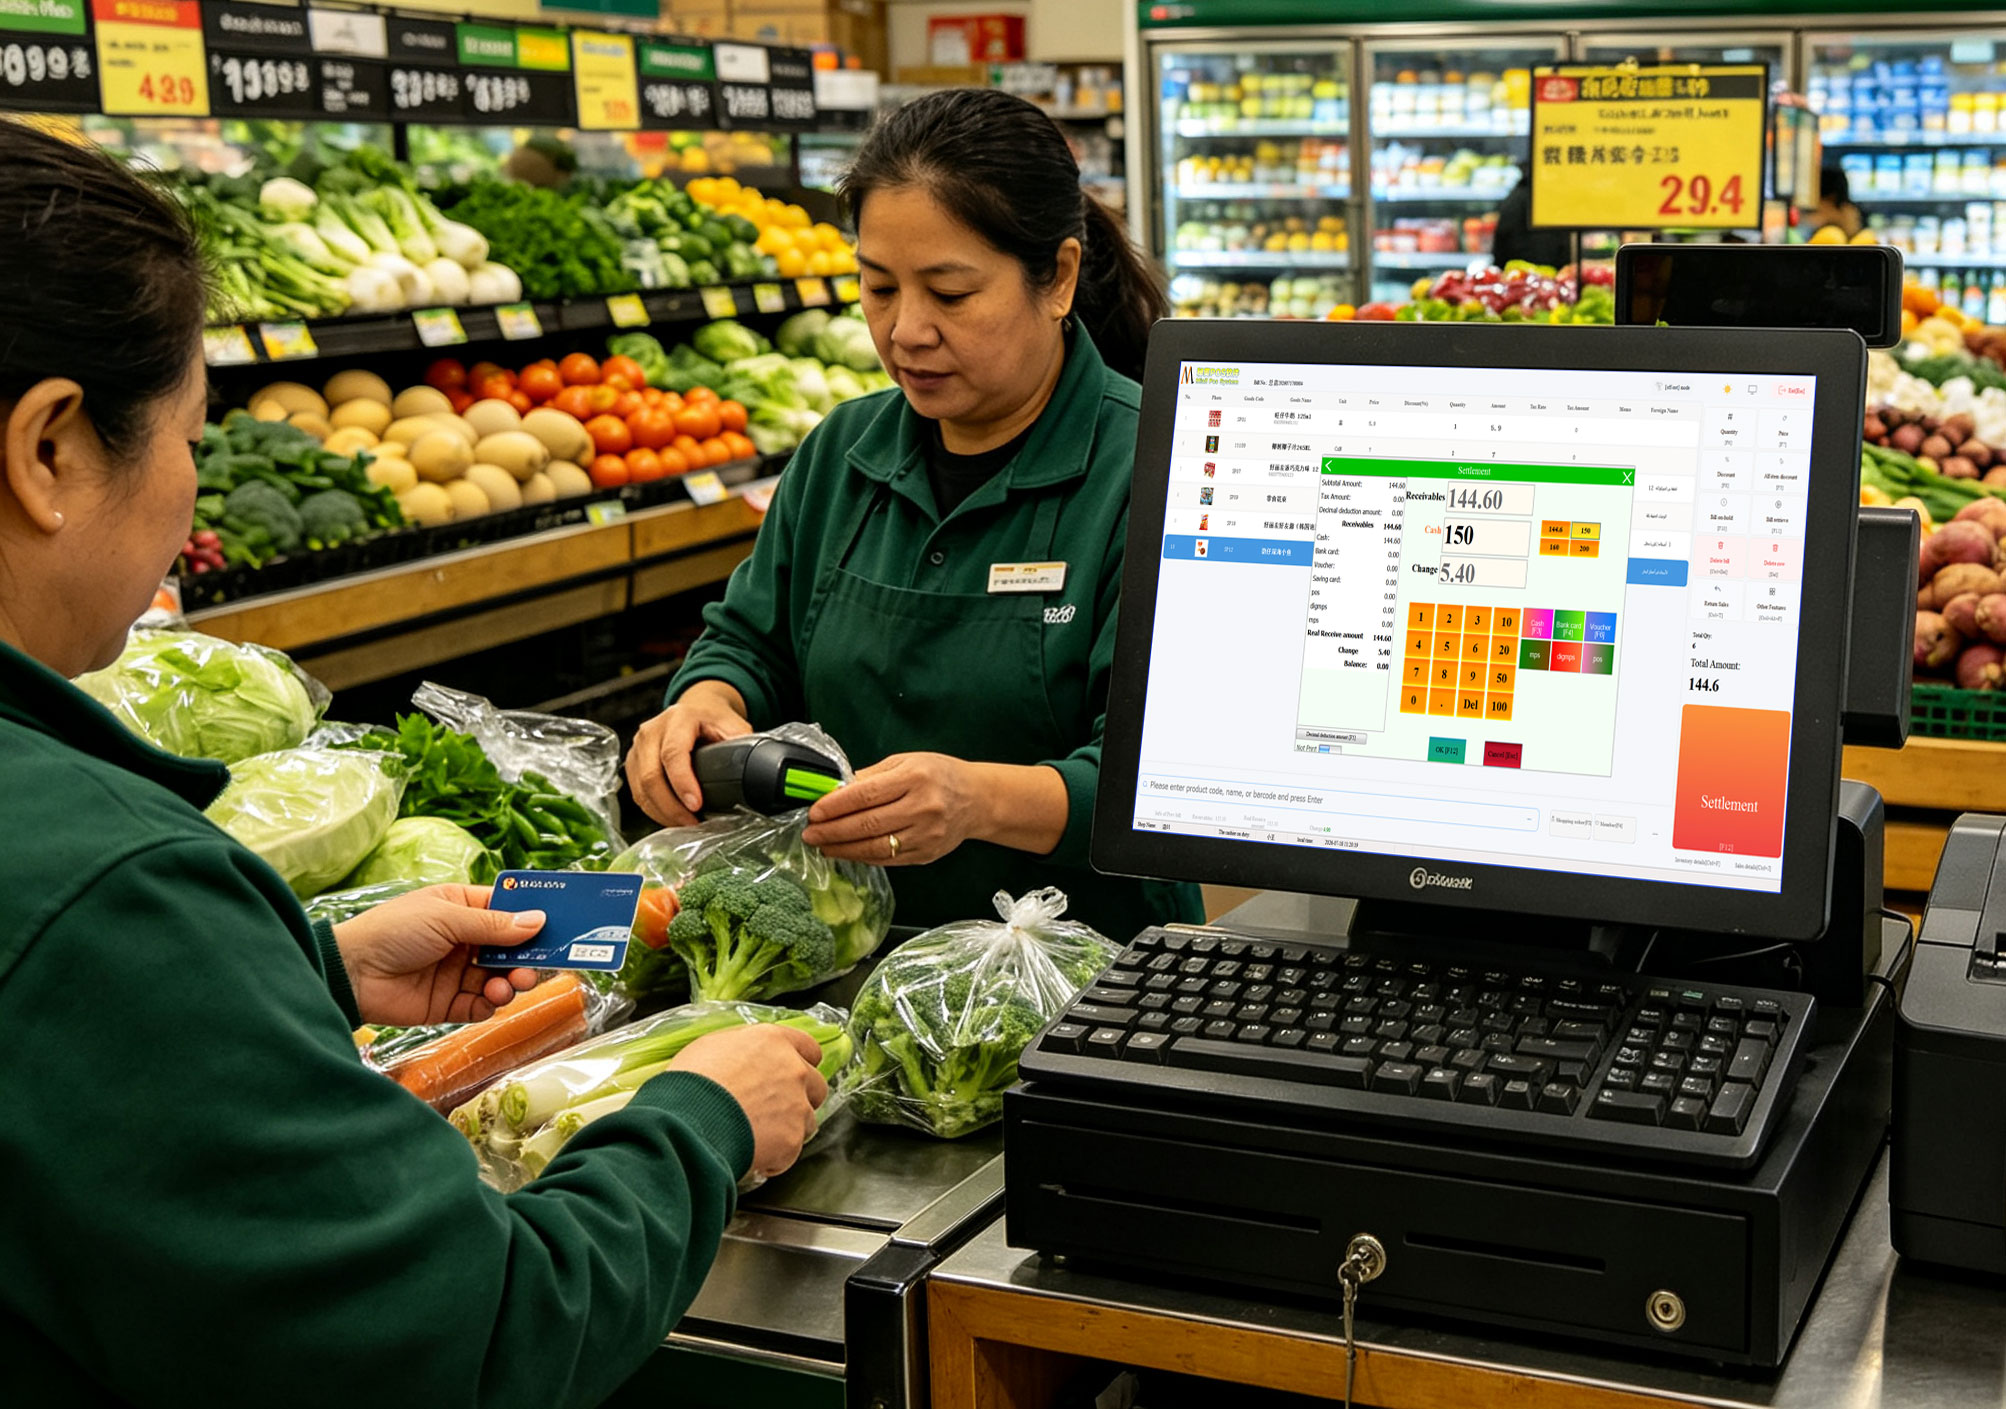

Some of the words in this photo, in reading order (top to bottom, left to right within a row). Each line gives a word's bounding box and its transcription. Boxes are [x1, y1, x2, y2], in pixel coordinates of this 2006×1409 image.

[1658, 174, 1744, 216] 29.4
[1457, 466, 1491, 477] Settlement
[1321, 478, 1341, 487] Subtotal
[1342, 480, 1362, 488] Amount:
[1388, 481, 1406, 490] 144.60
[1320, 492, 1329, 500] Tax
[1329, 493, 1351, 502] Amount:
[1393, 496, 1405, 504] 0.00
[1405, 490, 1446, 502] Receivables
[1448, 488, 1503, 510] 144.60
[1319, 505, 1337, 514] Decimal
[1337, 506, 1362, 516] deduction
[1362, 508, 1383, 517] amount:
[1391, 509, 1404, 517] 0.00
[1341, 520, 1374, 530] Receivables
[1383, 523, 1402, 532] 144.60
[1424, 524, 1442, 535] Cash
[1548, 525, 1563, 533] 144.6
[1316, 533, 1330, 542] Cash:
[1445, 524, 1474, 545] 150
[1383, 537, 1401, 546] 144.60
[1315, 547, 1326, 555] Bank
[1326, 548, 1340, 556] card:
[1387, 551, 1400, 559] 0.00
[1314, 561, 1335, 570] Voucher:
[1386, 564, 1398, 573] 0.00
[1411, 563, 1439, 575] Change
[1439, 562, 1475, 584] 5.40
[1312, 575, 1328, 584] Saving
[1327, 576, 1341, 584] card:
[1385, 578, 1397, 587] 0.00
[1311, 589, 1320, 597] pos
[1384, 592, 1396, 601] 0.00
[1383, 606, 1394, 615] 0.00
[1418, 611, 1424, 622] 1
[1446, 613, 1452, 624] 2
[1474, 615, 1481, 626] 3
[1381, 620, 1393, 628] 0.00
[1501, 617, 1512, 627] 10
[1530, 619, 1544, 628] Cash
[1556, 621, 1569, 629] Bank
[1570, 622, 1582, 630] card
[1590, 622, 1611, 632] Voucher
[1307, 628, 1320, 637] Real
[1320, 629, 1342, 638] Receive
[1342, 631, 1364, 640] amount
[1373, 634, 1392, 643] 144.60
[1692, 631, 1703, 639] Total
[1703, 632, 1712, 640] Qty:
[1415, 640, 1422, 650] 4
[1444, 641, 1450, 651] 5
[1472, 643, 1478, 653] 6
[1498, 645, 1510, 655] 20
[1338, 646, 1359, 655] Change
[1378, 648, 1391, 657] 5.40
[1344, 659, 1368, 669] Balance:
[1592, 656, 1603, 665] pos
[1690, 657, 1709, 668] Total
[1709, 659, 1741, 671] Amount:
[1376, 662, 1389, 671] 0.00
[1413, 667, 1420, 677] 7
[1441, 669, 1448, 680] 8
[1469, 671, 1476, 681] 9
[1496, 673, 1507, 684] 50
[1688, 677, 1720, 692] 144.6
[1411, 695, 1417, 705] 0
[1463, 699, 1478, 710] Del
[1491, 701, 1507, 712] 100
[1296, 744, 1306, 752] Not
[1306, 745, 1318, 753] Print
[1435, 745, 1444, 753] OK
[1487, 750, 1504, 759] Cancel
[1150, 780, 1169, 791] Please
[1170, 784, 1185, 792] enter
[1186, 784, 1208, 795] product
[1209, 786, 1224, 796] code,
[1225, 789, 1244, 799] name,
[1253, 790, 1276, 800] barcode
[1277, 792, 1288, 802] and
[1290, 795, 1306, 803] press
[1307, 795, 1323, 804] Enter
[1701, 794, 1758, 813] Settlement
